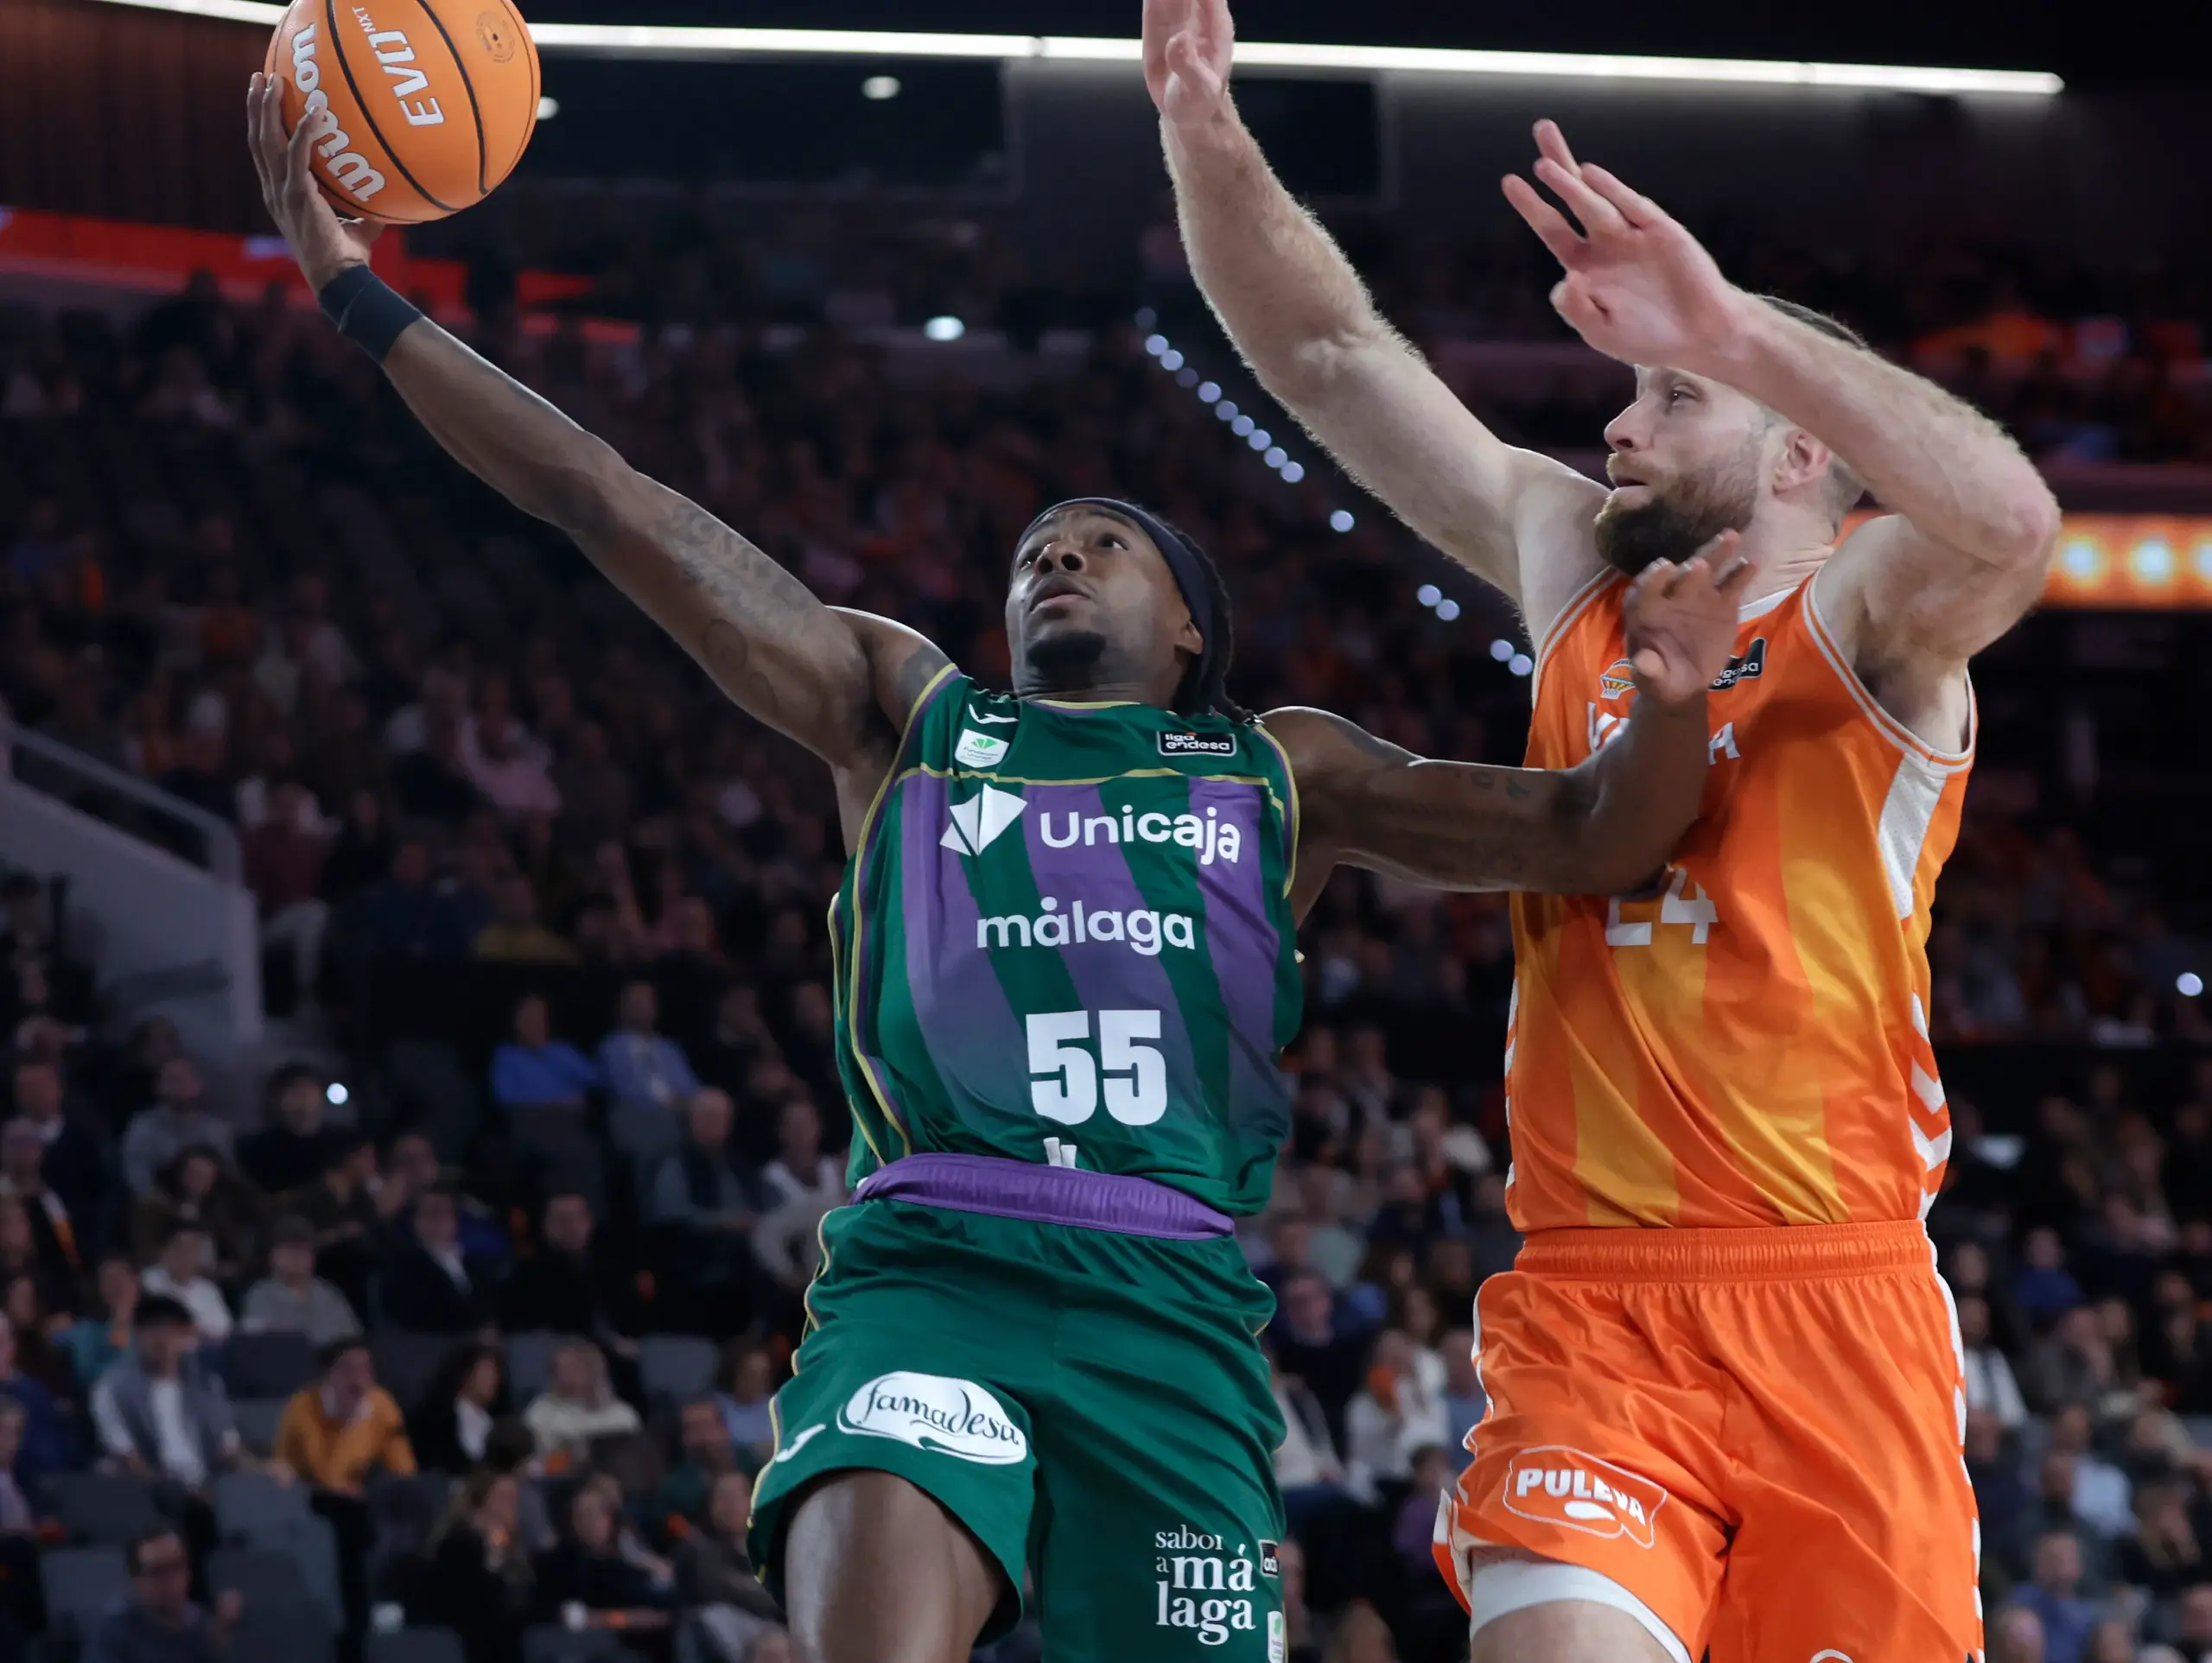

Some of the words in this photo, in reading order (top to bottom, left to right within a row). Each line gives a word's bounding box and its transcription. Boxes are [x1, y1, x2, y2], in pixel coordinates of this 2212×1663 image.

[352, 6, 376, 33] NXT
[367, 30, 445, 126] EVO
[1165, 733, 1195, 742] liga
[1166, 740, 1230, 751] endesa
[1039, 804, 1242, 866] Unicaja
[1026, 1010, 1167, 1126] 55
[857, 1377, 1020, 1445] famadesa
[1155, 1524, 1224, 1550] sabor
[1156, 1557, 1169, 1573] a
[1172, 1544, 1255, 1591] má
[1156, 1580, 1256, 1646] laga
